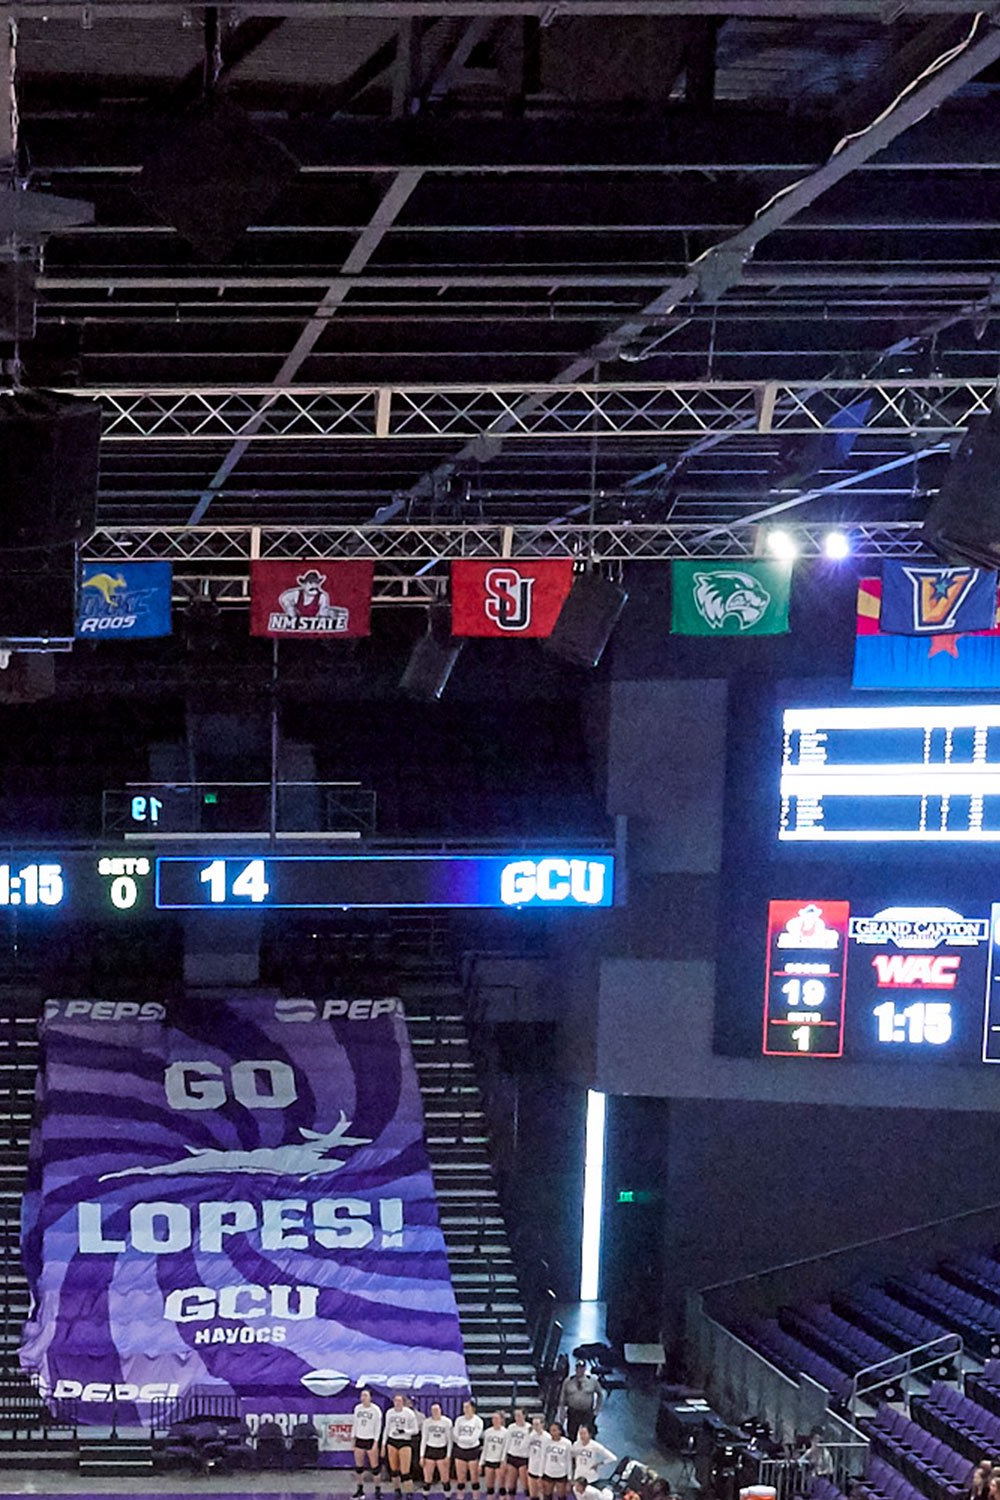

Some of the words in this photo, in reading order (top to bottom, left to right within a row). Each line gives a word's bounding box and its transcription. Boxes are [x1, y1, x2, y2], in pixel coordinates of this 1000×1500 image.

[81, 615, 136, 633] ROOS
[270, 615, 297, 631] NM
[298, 612, 346, 631] STATE
[110, 876, 137, 910] 0
[200, 859, 270, 903] 14
[500, 858, 606, 906] GCU
[856, 919, 911, 936] GRAND
[916, 919, 980, 937] CANYON
[872, 955, 961, 989] WAC
[782, 978, 827, 1007] 19
[792, 1025, 811, 1051] 1
[872, 1001, 953, 1045] 1:15
[164, 1059, 299, 1111] GO
[77, 1197, 404, 1254] LOPES!
[164, 1284, 320, 1324] GCU
[195, 1324, 286, 1345] HAVOCS
[53, 1379, 180, 1403] PEPSI
[355, 1373, 471, 1389] PEPS
